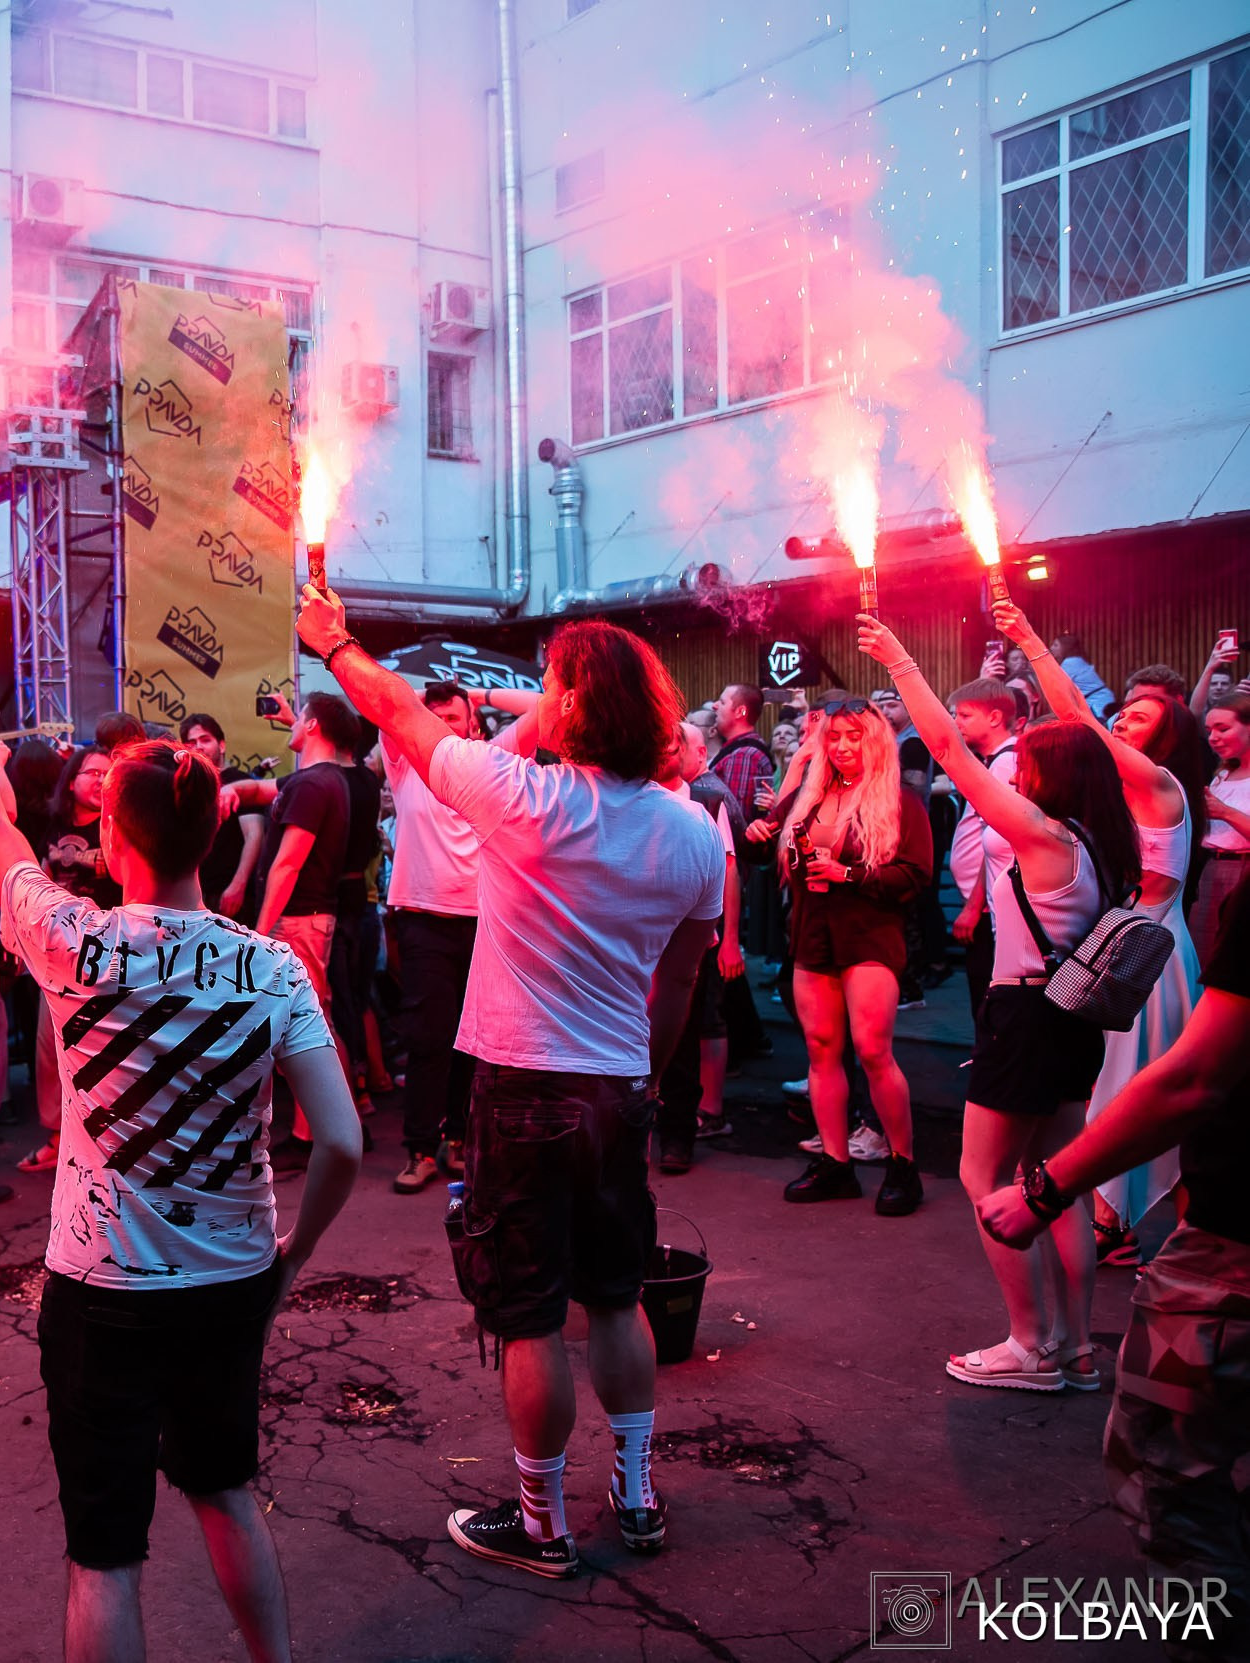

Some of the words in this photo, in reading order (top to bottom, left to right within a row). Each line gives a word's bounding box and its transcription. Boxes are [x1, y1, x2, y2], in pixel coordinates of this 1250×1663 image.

[174, 313, 235, 370] PRAVDA
[133, 377, 201, 445] PRAVDA
[123, 474, 159, 514] AVDA
[240, 461, 291, 509] PRAVD
[197, 530, 263, 594] PRAVDA
[165, 606, 224, 662] PRAVDA
[429, 662, 546, 694] PRAVD
[768, 652, 800, 672] VIP
[126, 670, 187, 722] PRAVD
